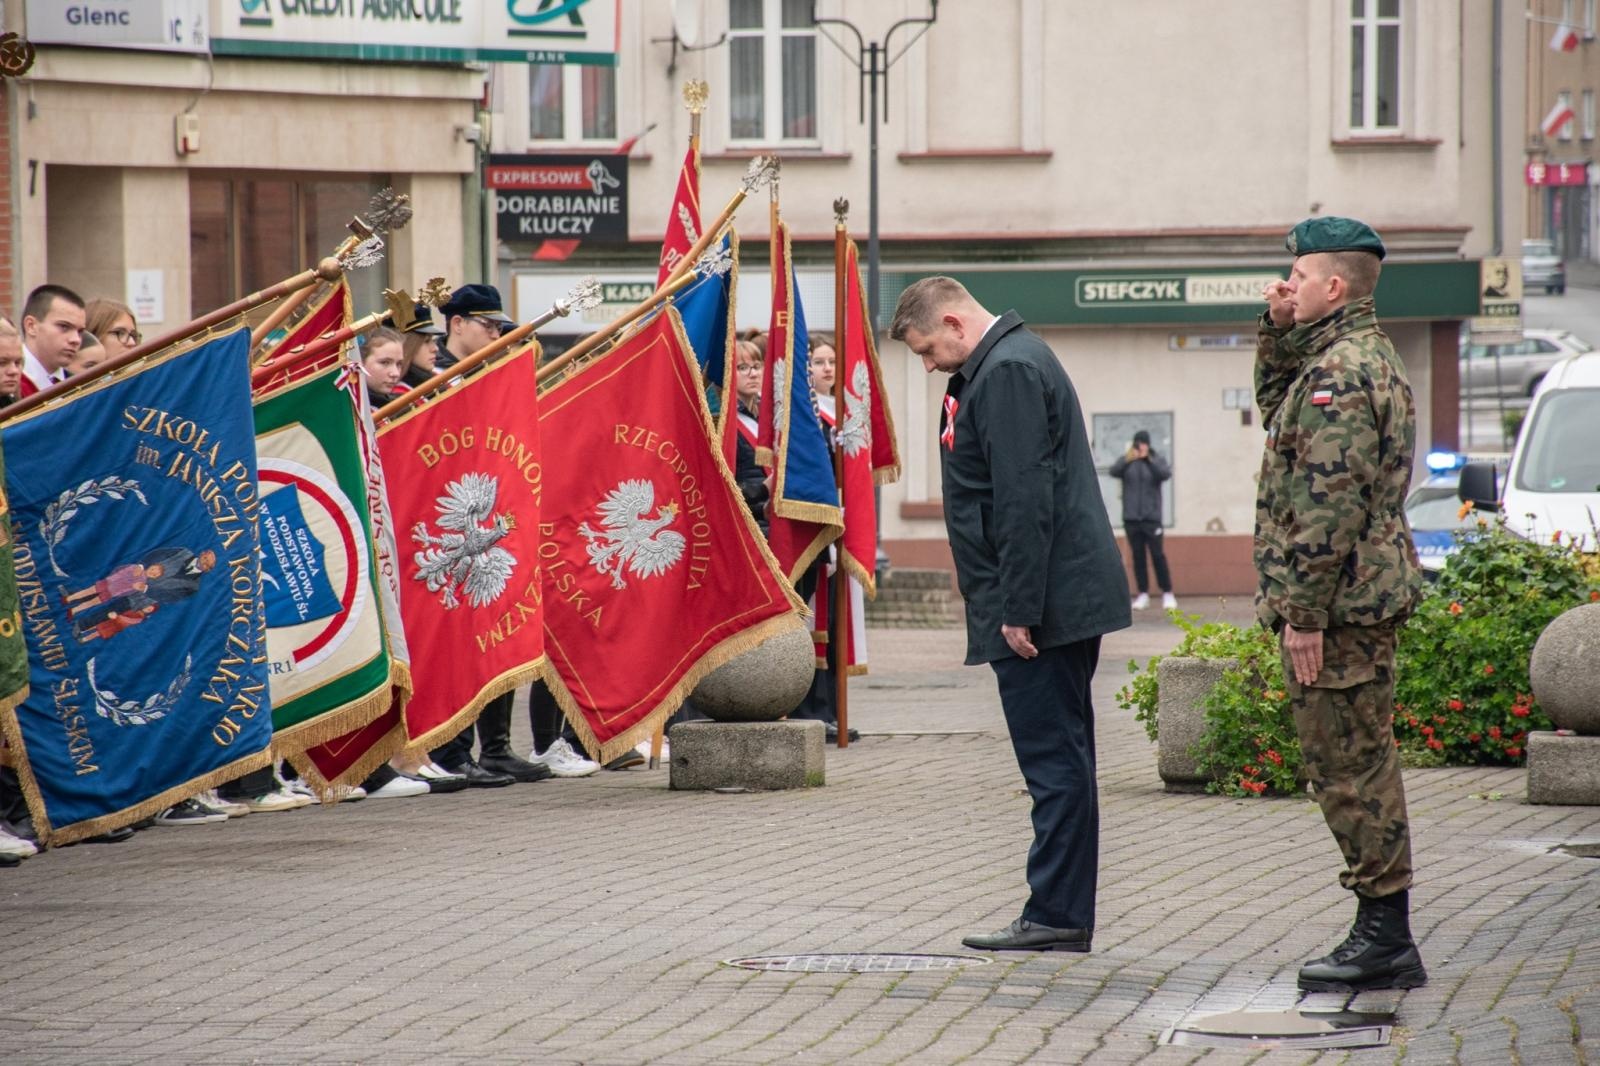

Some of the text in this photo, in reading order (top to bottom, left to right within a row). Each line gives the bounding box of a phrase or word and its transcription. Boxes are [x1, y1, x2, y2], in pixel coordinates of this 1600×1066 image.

[65, 7, 130, 26] Glenc
[526, 51, 567, 62] BANK
[492, 171, 583, 185] EXPRESOWE
[496, 196, 621, 214] DORABIANIE
[519, 216, 595, 234] KLUCZY
[604, 284, 654, 301] KASA
[1084, 280, 1268, 300] STEFCZYK FINANS
[121, 405, 223, 468] SZKOŁA
[417, 426, 475, 469] BÓG
[613, 423, 712, 591] RZECZPOSPOLITA
[263, 516, 304, 602] WODZISŁAWIU
[275, 514, 315, 600] PODSTAWOWA
[294, 527, 321, 578] SZKOŁA
[537, 522, 603, 628] POLSKA
